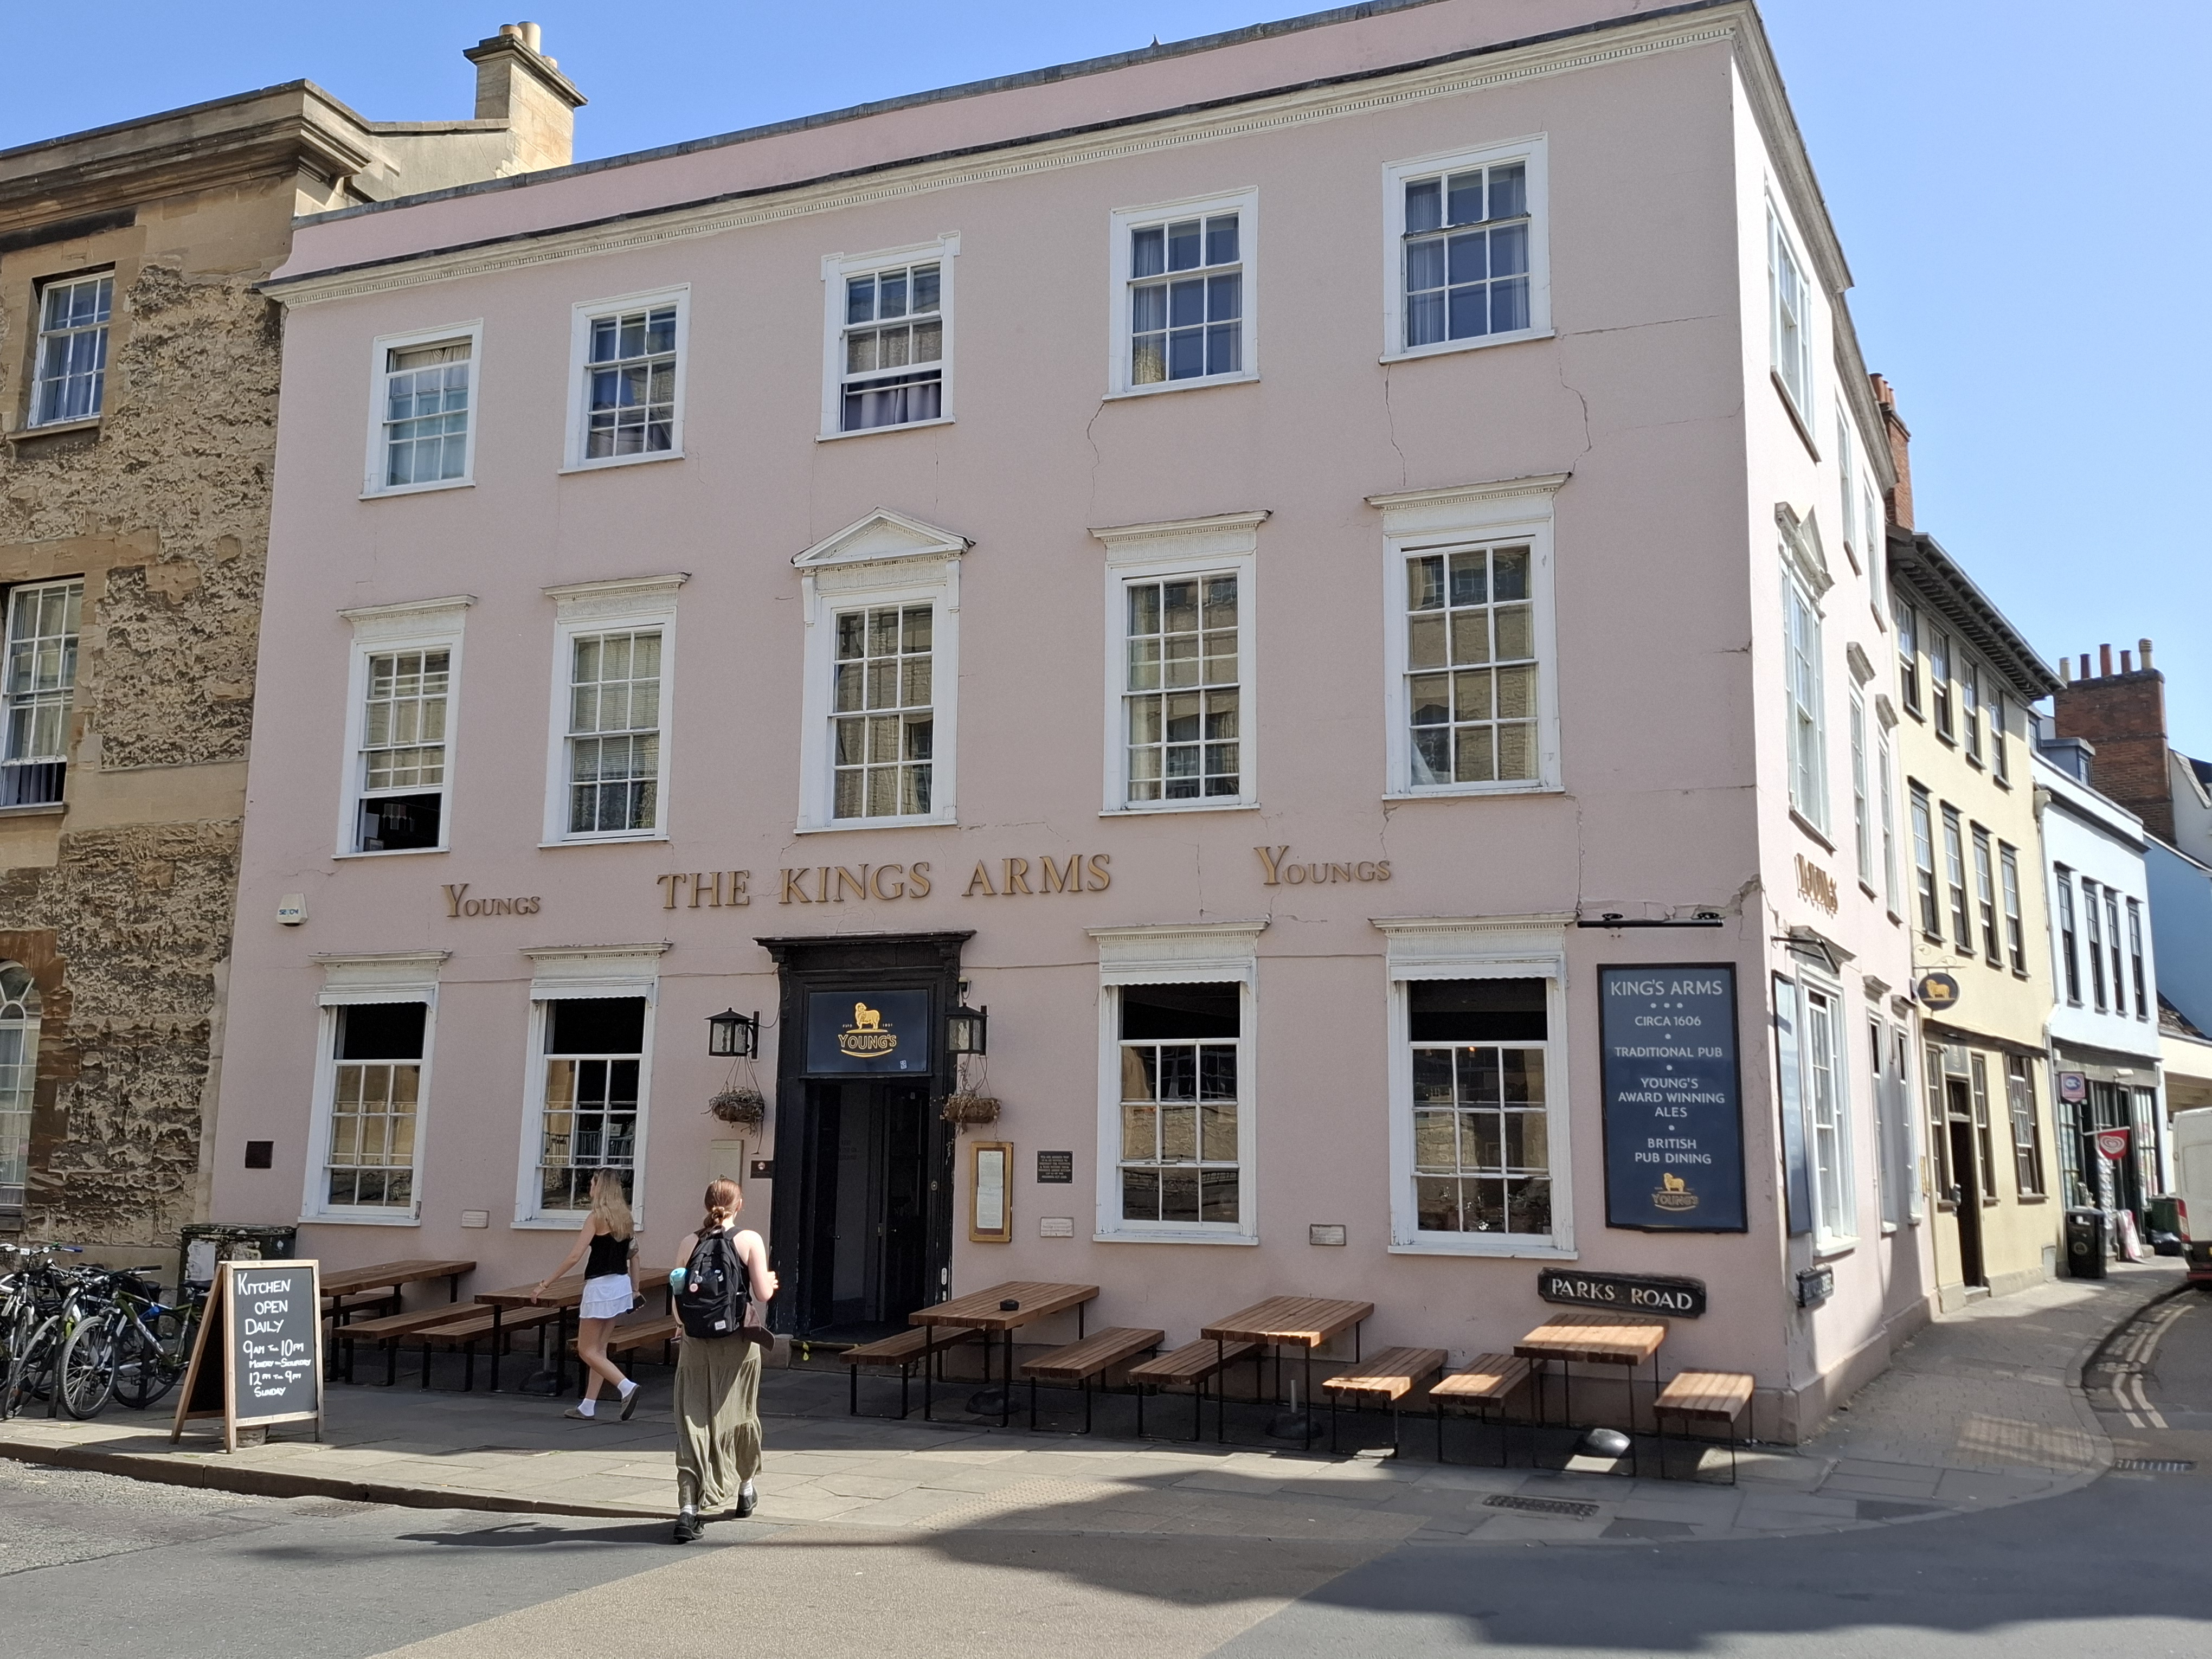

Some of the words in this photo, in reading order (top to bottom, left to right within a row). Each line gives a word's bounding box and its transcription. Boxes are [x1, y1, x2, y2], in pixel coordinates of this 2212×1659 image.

[657, 869, 750, 910] THE
[778, 861, 931, 904] KINGS
[961, 853, 1111, 897] ARMS
[1610, 980, 1664, 996] KING'S
[1670, 980, 1724, 995] ARMS
[1635, 1016, 1671, 1026] CIRCA
[1673, 1016, 1701, 1026] 1606
[838, 1034, 897, 1050] YOUNG'S
[1614, 1047, 1694, 1058] TRADITIONAL
[1697, 1047, 1723, 1057] PUB
[1641, 1077, 1699, 1089] YOUNG'S
[1618, 1092, 1663, 1103] AWARD
[1666, 1092, 1725, 1104] WINNING
[1654, 1107, 1687, 1118] ALES
[1647, 1138, 1696, 1149] BRITISH
[1635, 1152, 1660, 1163] PUB
[1665, 1153, 1712, 1165] DINING
[1552, 1278, 1616, 1301] PARKS
[1631, 1288, 1693, 1310] ROAD
[254, 1300, 288, 1315] OPEN
